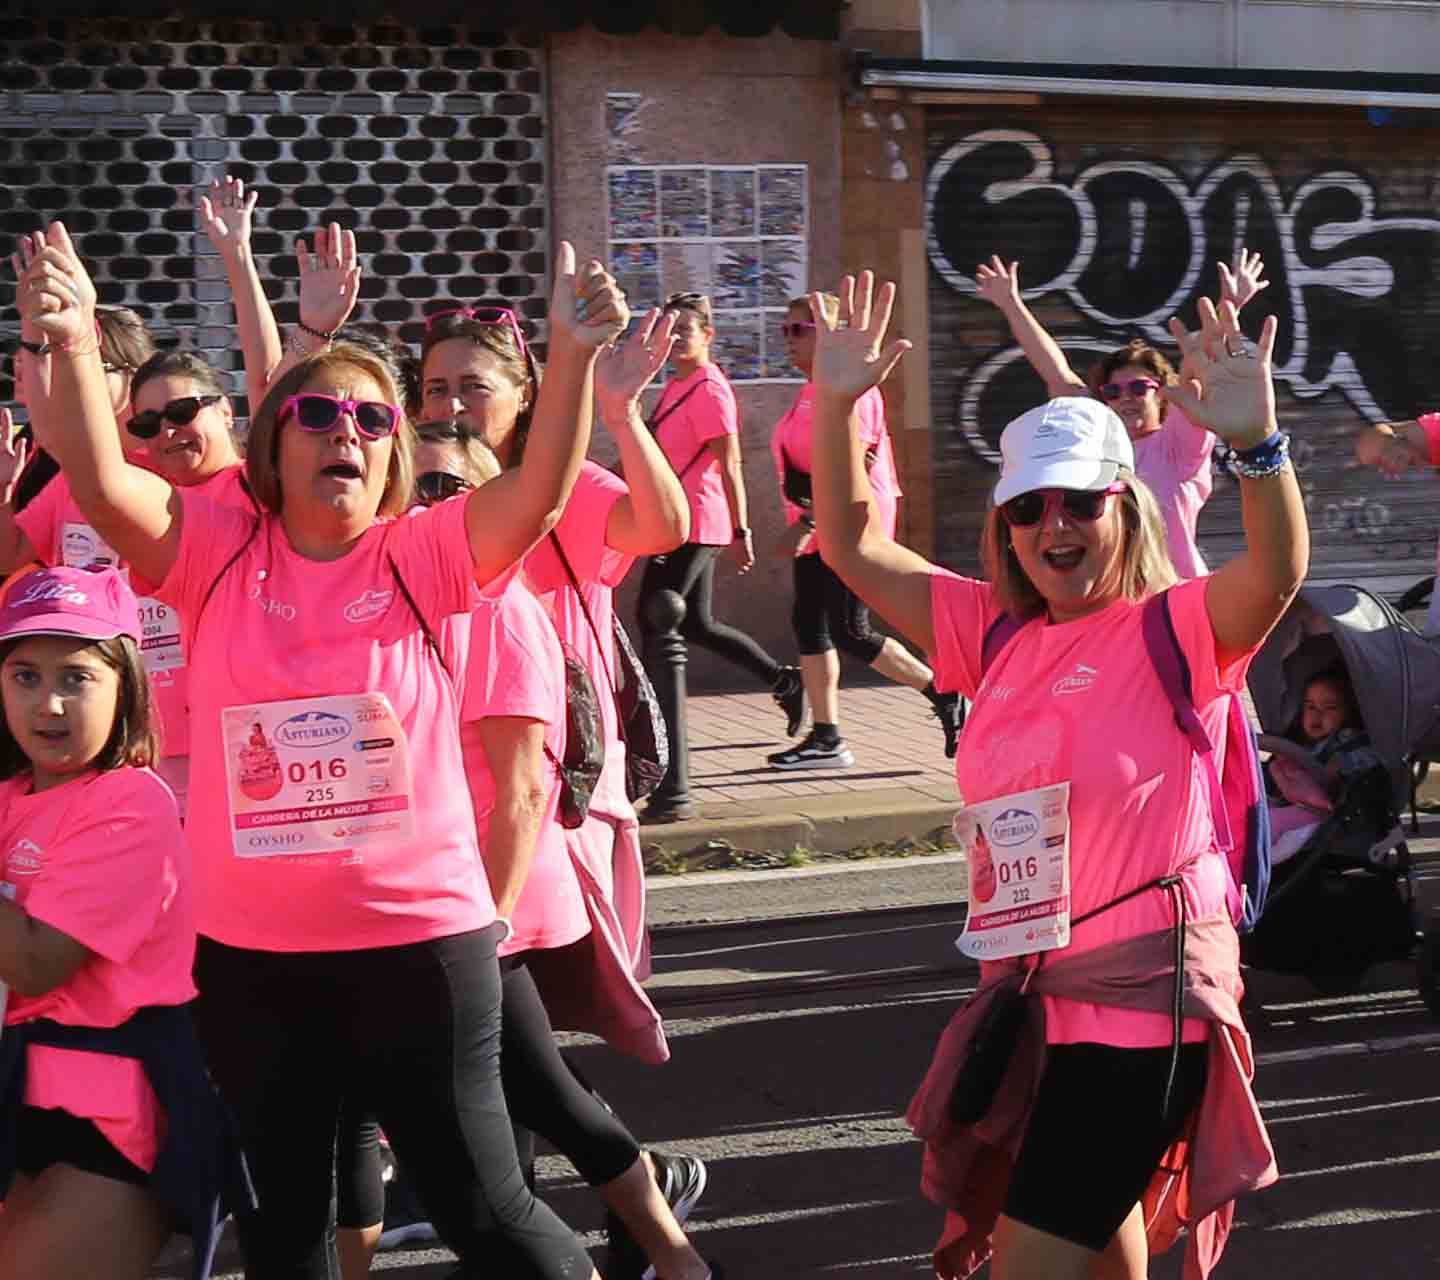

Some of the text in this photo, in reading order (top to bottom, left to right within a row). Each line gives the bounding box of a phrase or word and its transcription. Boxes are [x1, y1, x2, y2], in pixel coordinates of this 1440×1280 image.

[10, 578, 88, 609] Lita
[281, 724, 346, 741] ASTURIANA
[287, 758, 347, 784] 016
[305, 788, 335, 802] 235
[251, 811, 302, 823] CARRERA
[318, 808, 334, 818] LA
[334, 805, 369, 817] MUJER
[249, 833, 304, 847] OYSHO
[999, 856, 1038, 883] 016
[1012, 888, 1030, 904] 232
